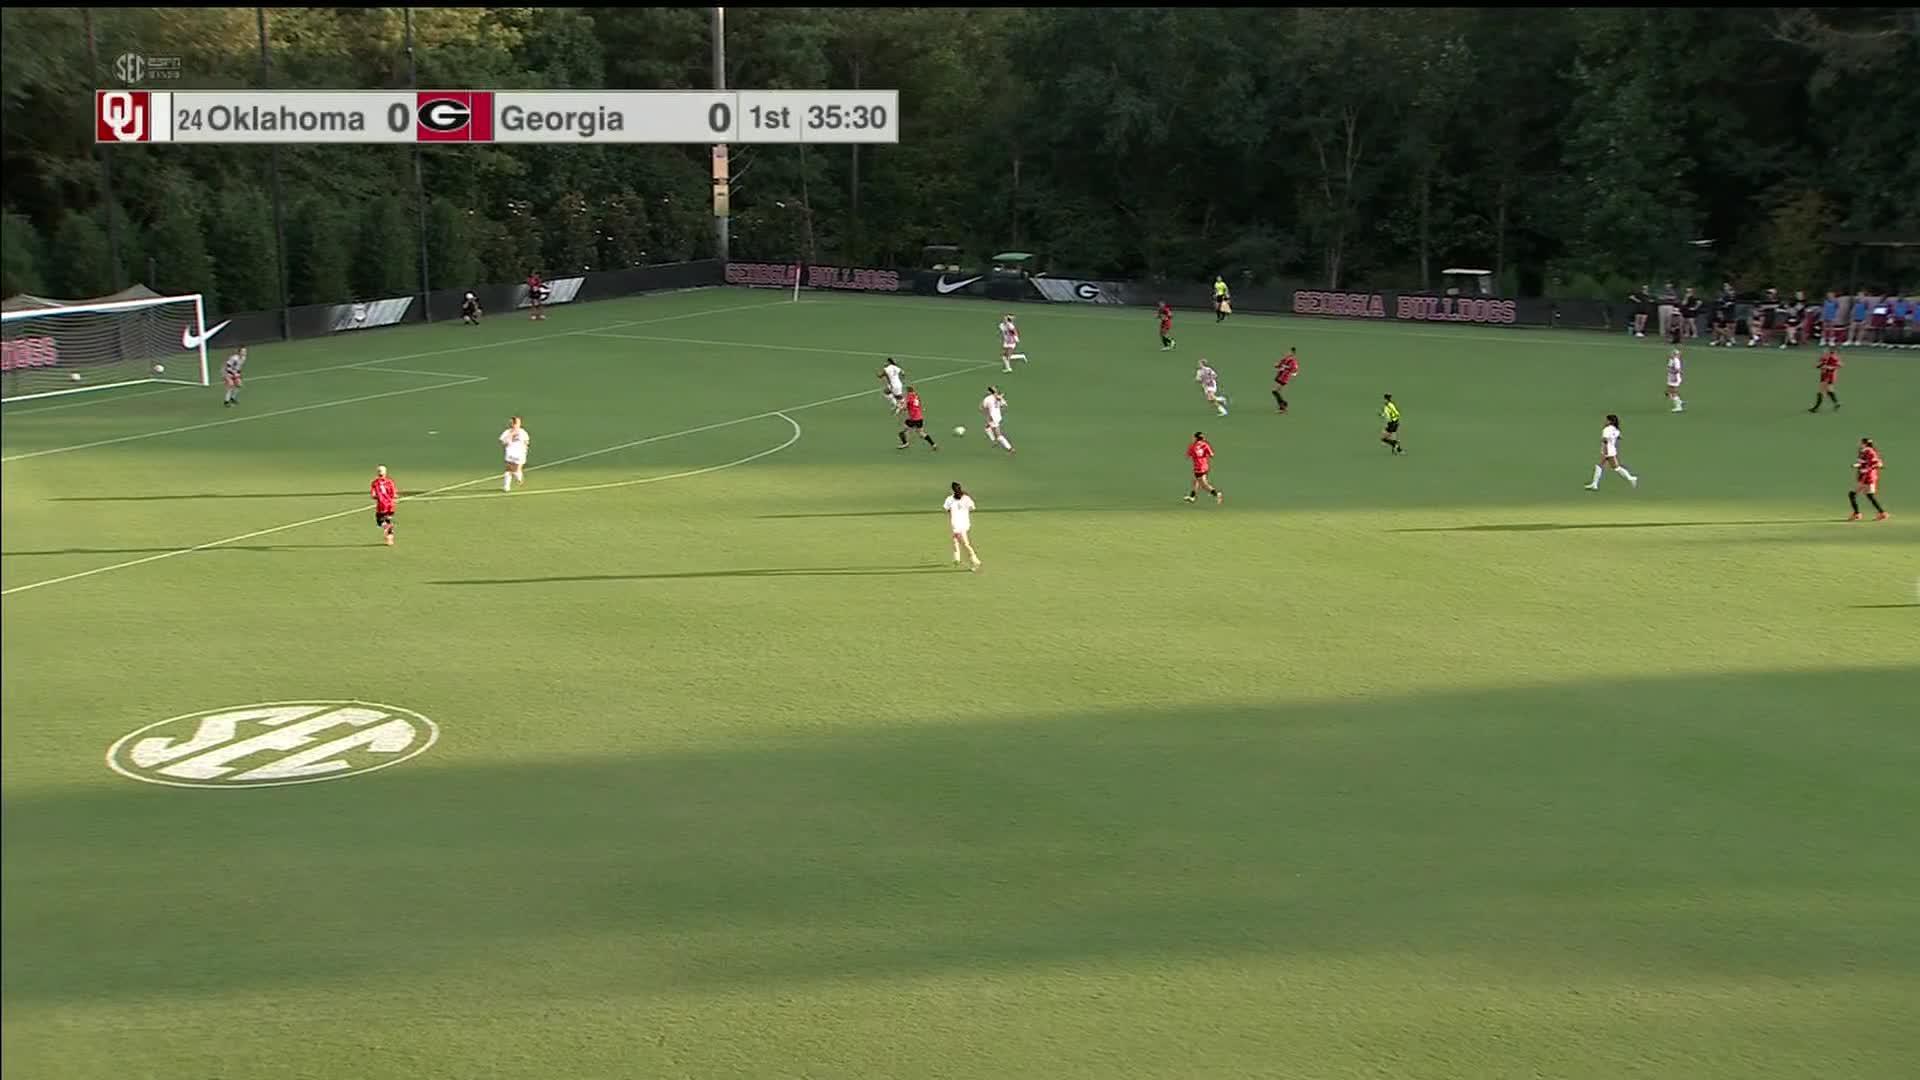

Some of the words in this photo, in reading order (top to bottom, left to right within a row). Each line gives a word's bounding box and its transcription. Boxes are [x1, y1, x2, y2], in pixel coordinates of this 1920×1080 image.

[1293, 290, 1386, 318] GEORGIA
[1396, 295, 1517, 324] BULLDOGS
[130, 706, 416, 780] SEC
